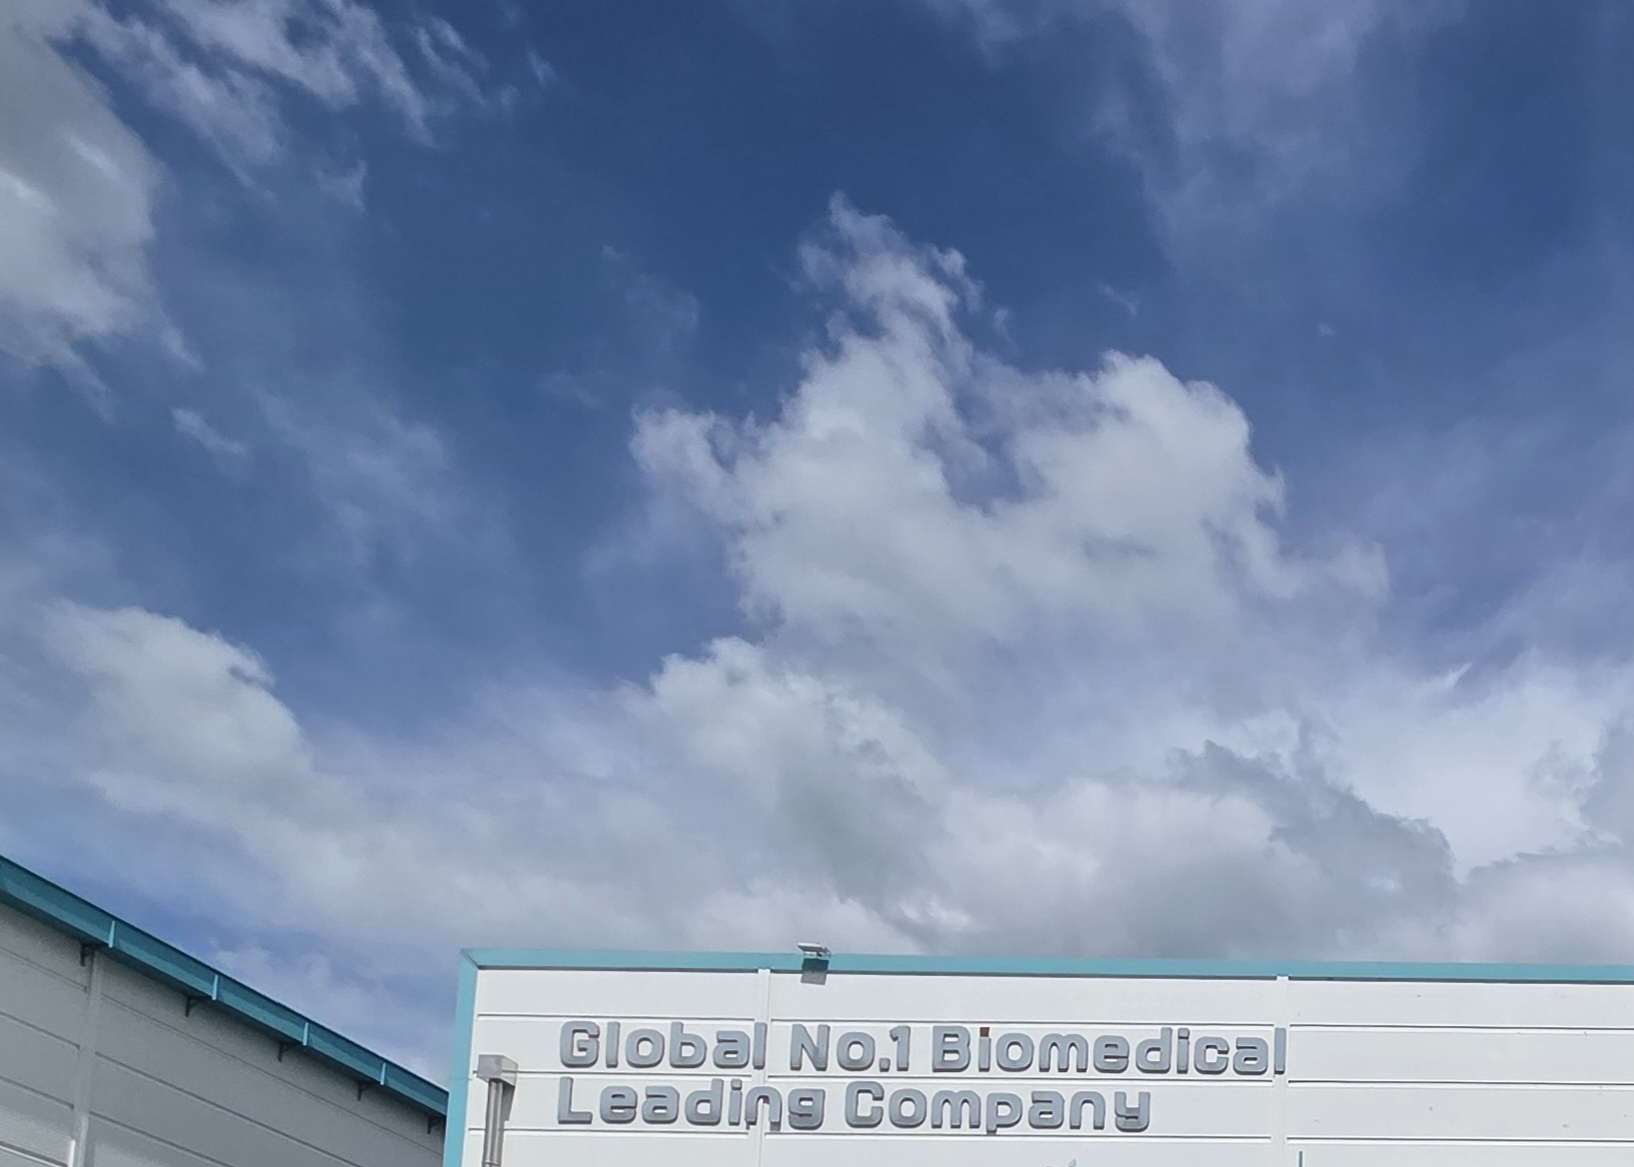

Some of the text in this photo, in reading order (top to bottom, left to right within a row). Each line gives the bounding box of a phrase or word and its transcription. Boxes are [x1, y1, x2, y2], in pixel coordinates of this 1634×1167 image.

[559, 1020, 1287, 1076] Global No.1 Biomedical
[557, 1076, 1151, 1134] Leading Company
